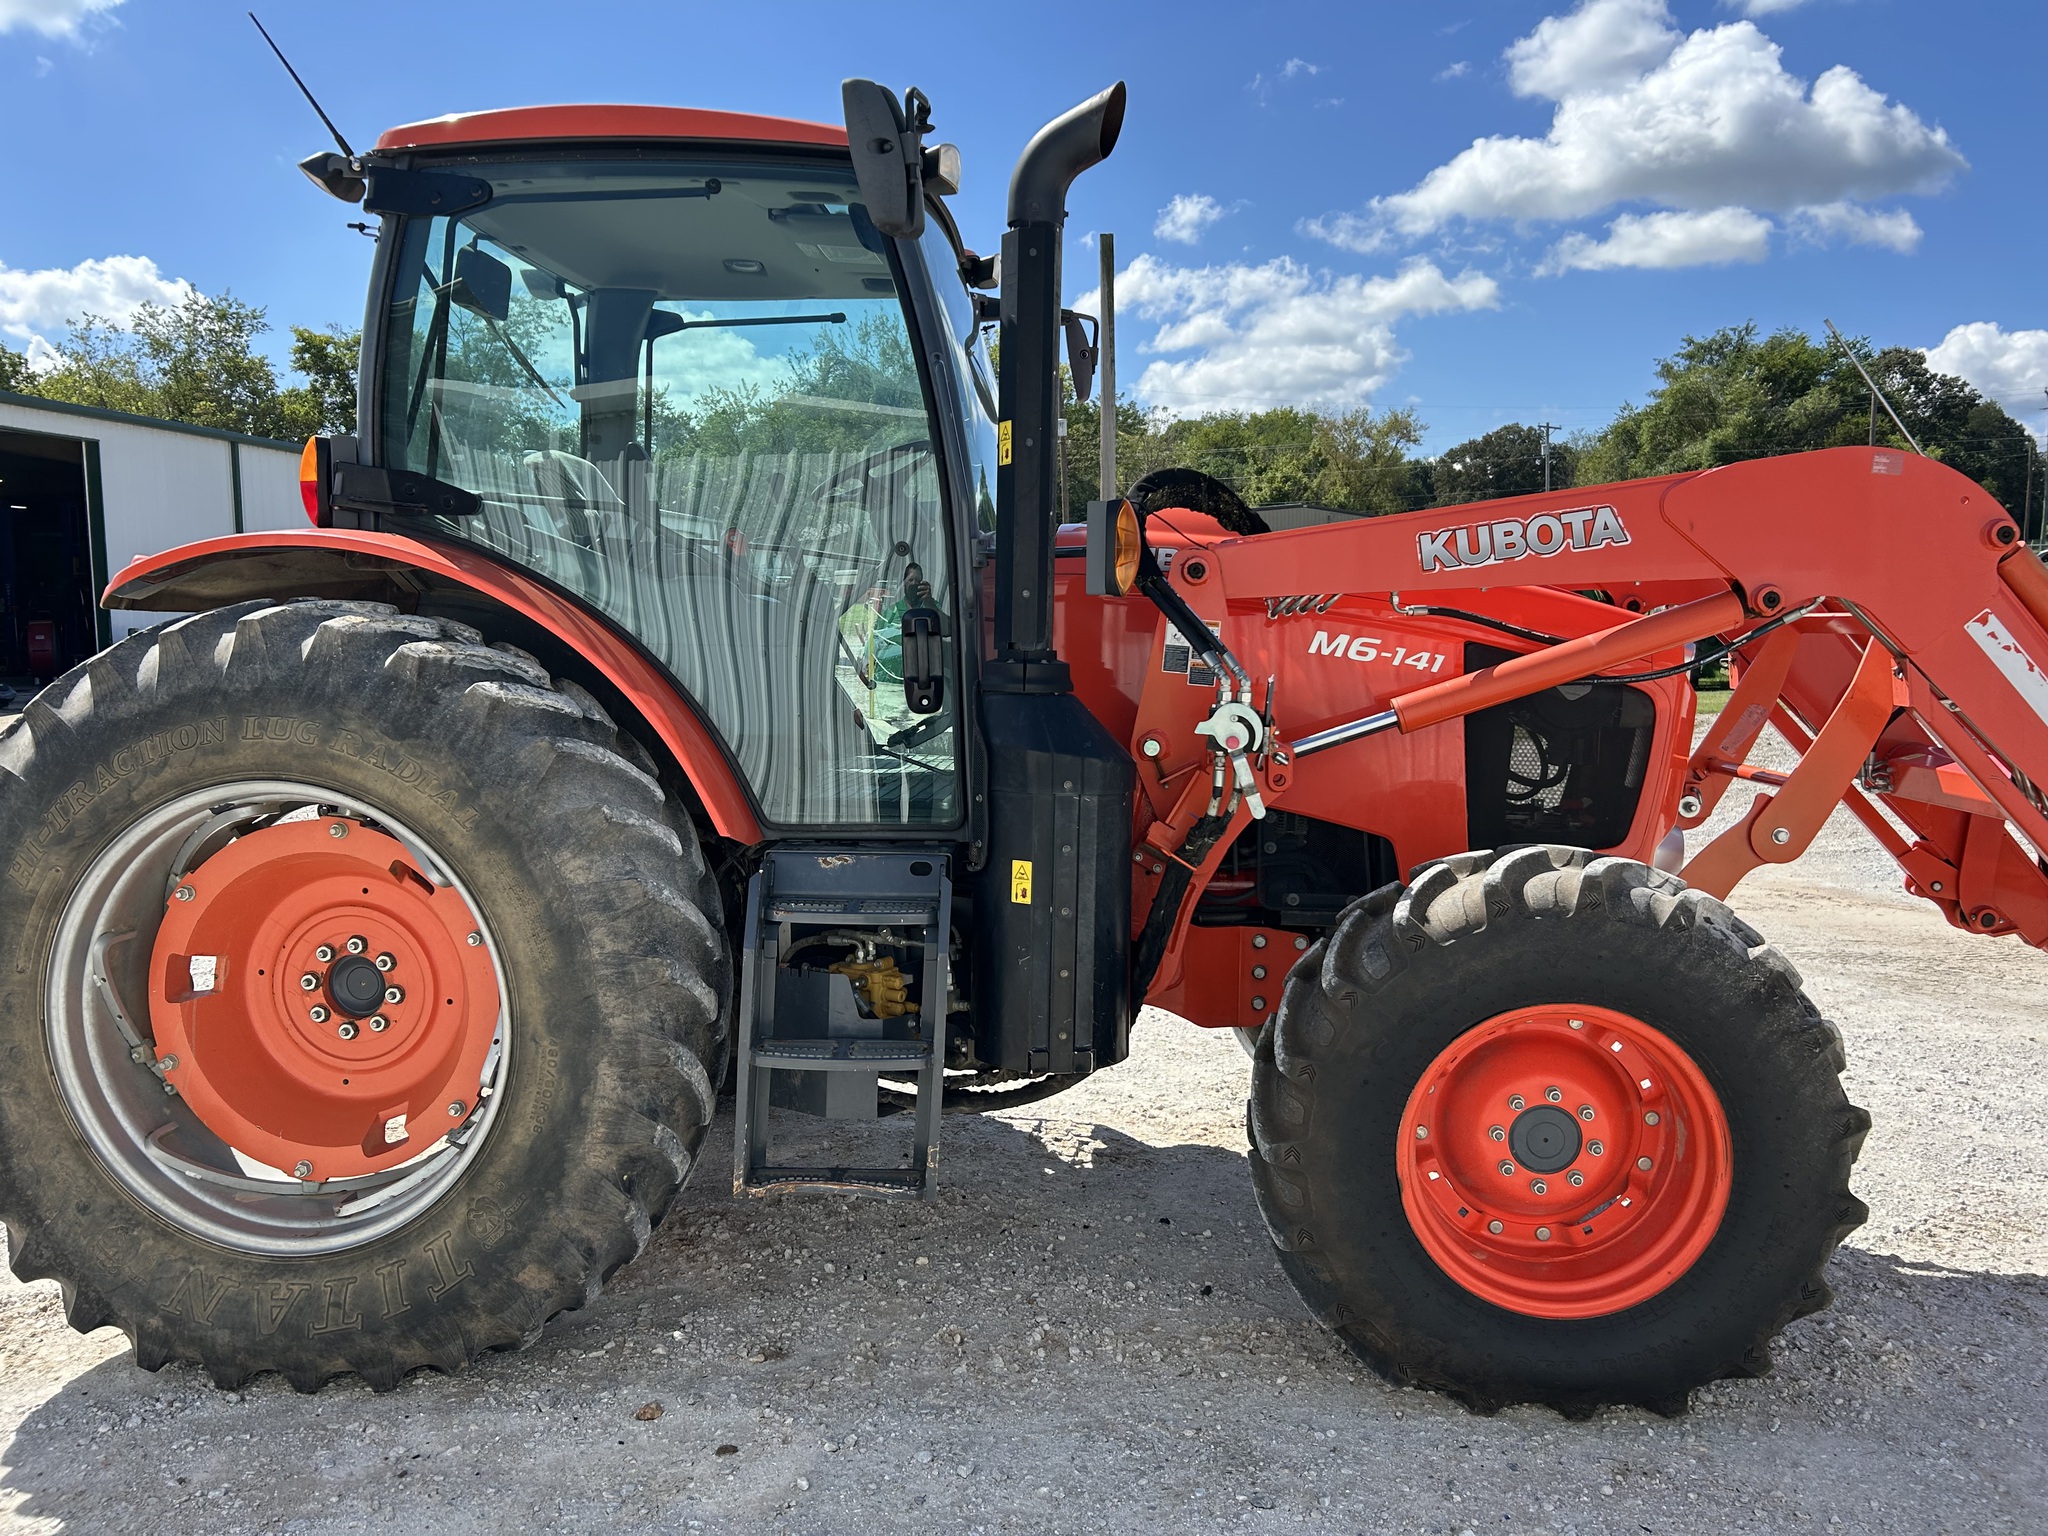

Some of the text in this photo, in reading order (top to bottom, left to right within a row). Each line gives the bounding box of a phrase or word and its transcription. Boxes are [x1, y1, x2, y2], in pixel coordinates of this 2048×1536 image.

[1417, 504, 1630, 573] KUBOTA
[1307, 630, 1446, 673] M6-141
[7, 715, 483, 890] HI-TRACTION LUG RADIAL
[160, 1230, 476, 1340] TITAN
